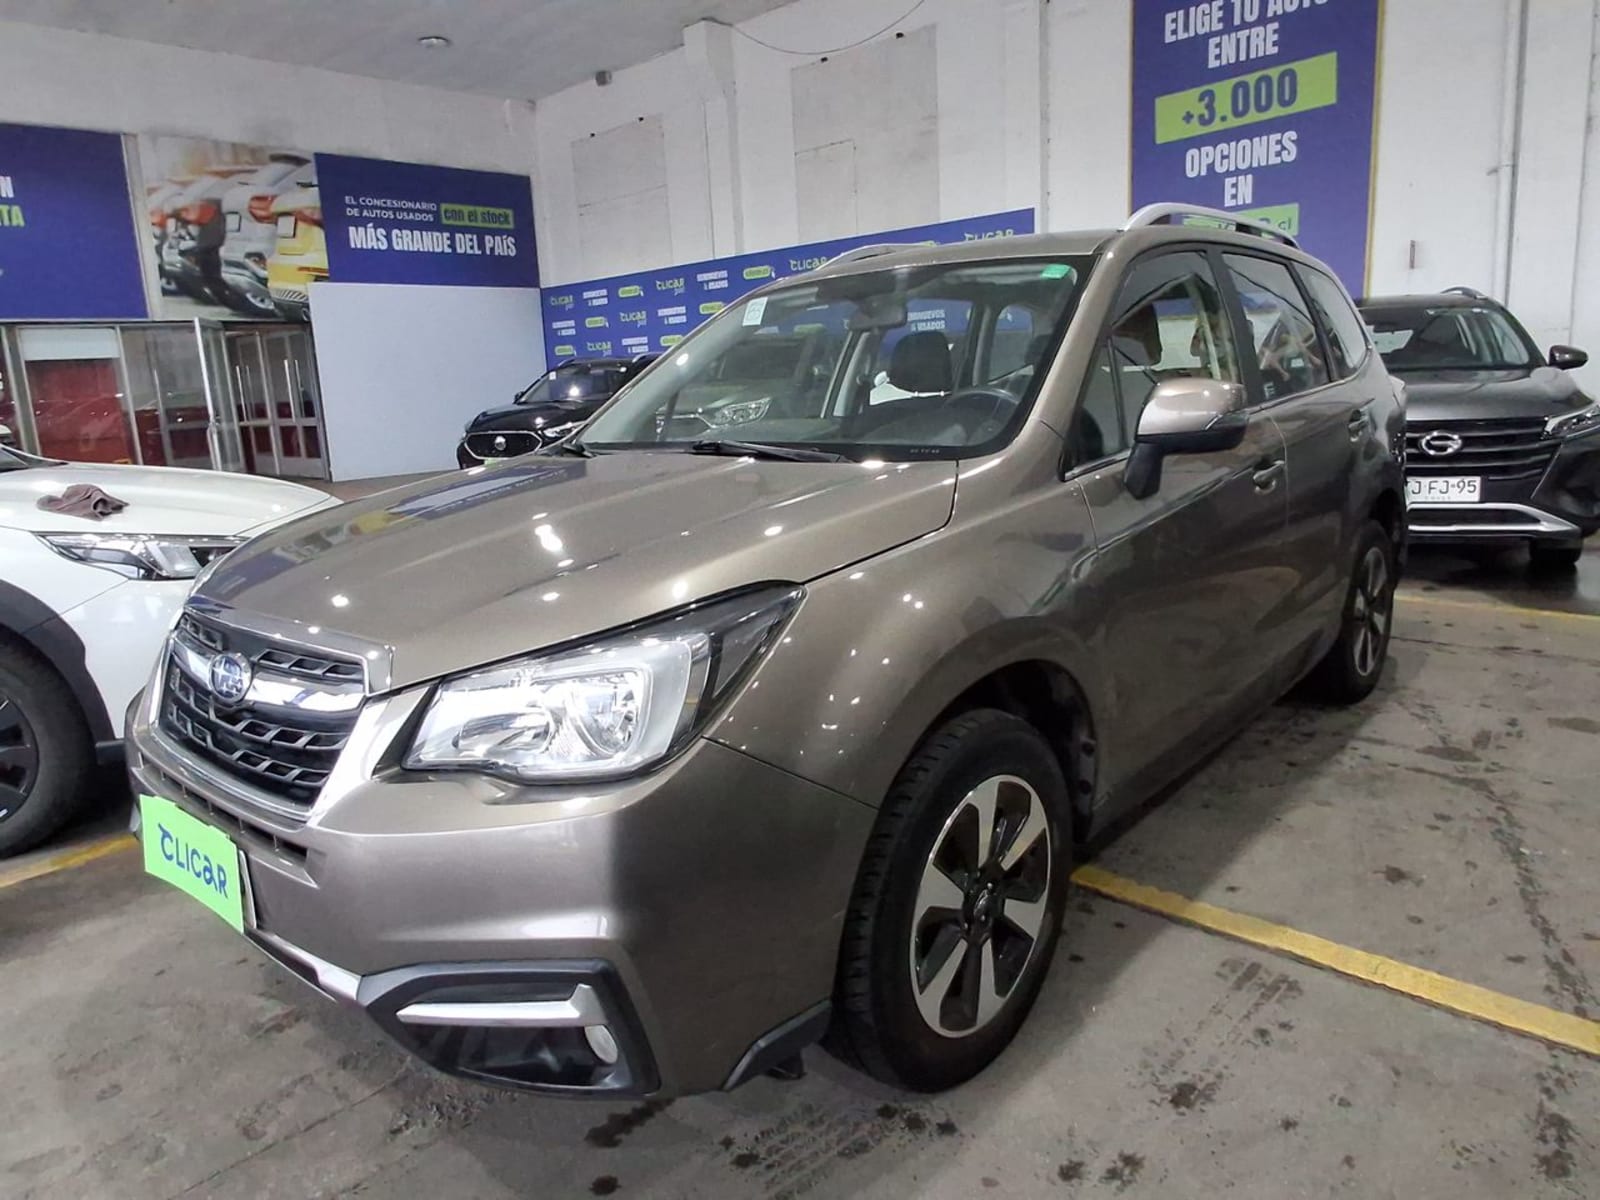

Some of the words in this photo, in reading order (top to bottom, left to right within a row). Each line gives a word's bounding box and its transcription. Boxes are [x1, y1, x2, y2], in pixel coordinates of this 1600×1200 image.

[1164, 0, 1225, 44] ELIGE
[1231, 0, 1260, 26] TU
[1207, 22, 1280, 69] ENTRE
[1182, 68, 1298, 127] +3.000
[1185, 130, 1298, 178] OPCIONES
[344, 196, 357, 205] EL
[359, 197, 437, 211] CONCESIONARIO
[1224, 174, 1253, 207] EN
[0, 204, 25, 228] TA
[346, 207, 360, 217] DE
[362, 208, 395, 219] AUTOS
[396, 210, 434, 222] USADOS
[348, 223, 388, 250] MÁS
[391, 228, 452, 254] GRANDE
[455, 233, 482, 255] DEL
[485, 234, 517, 257] PAÍS
